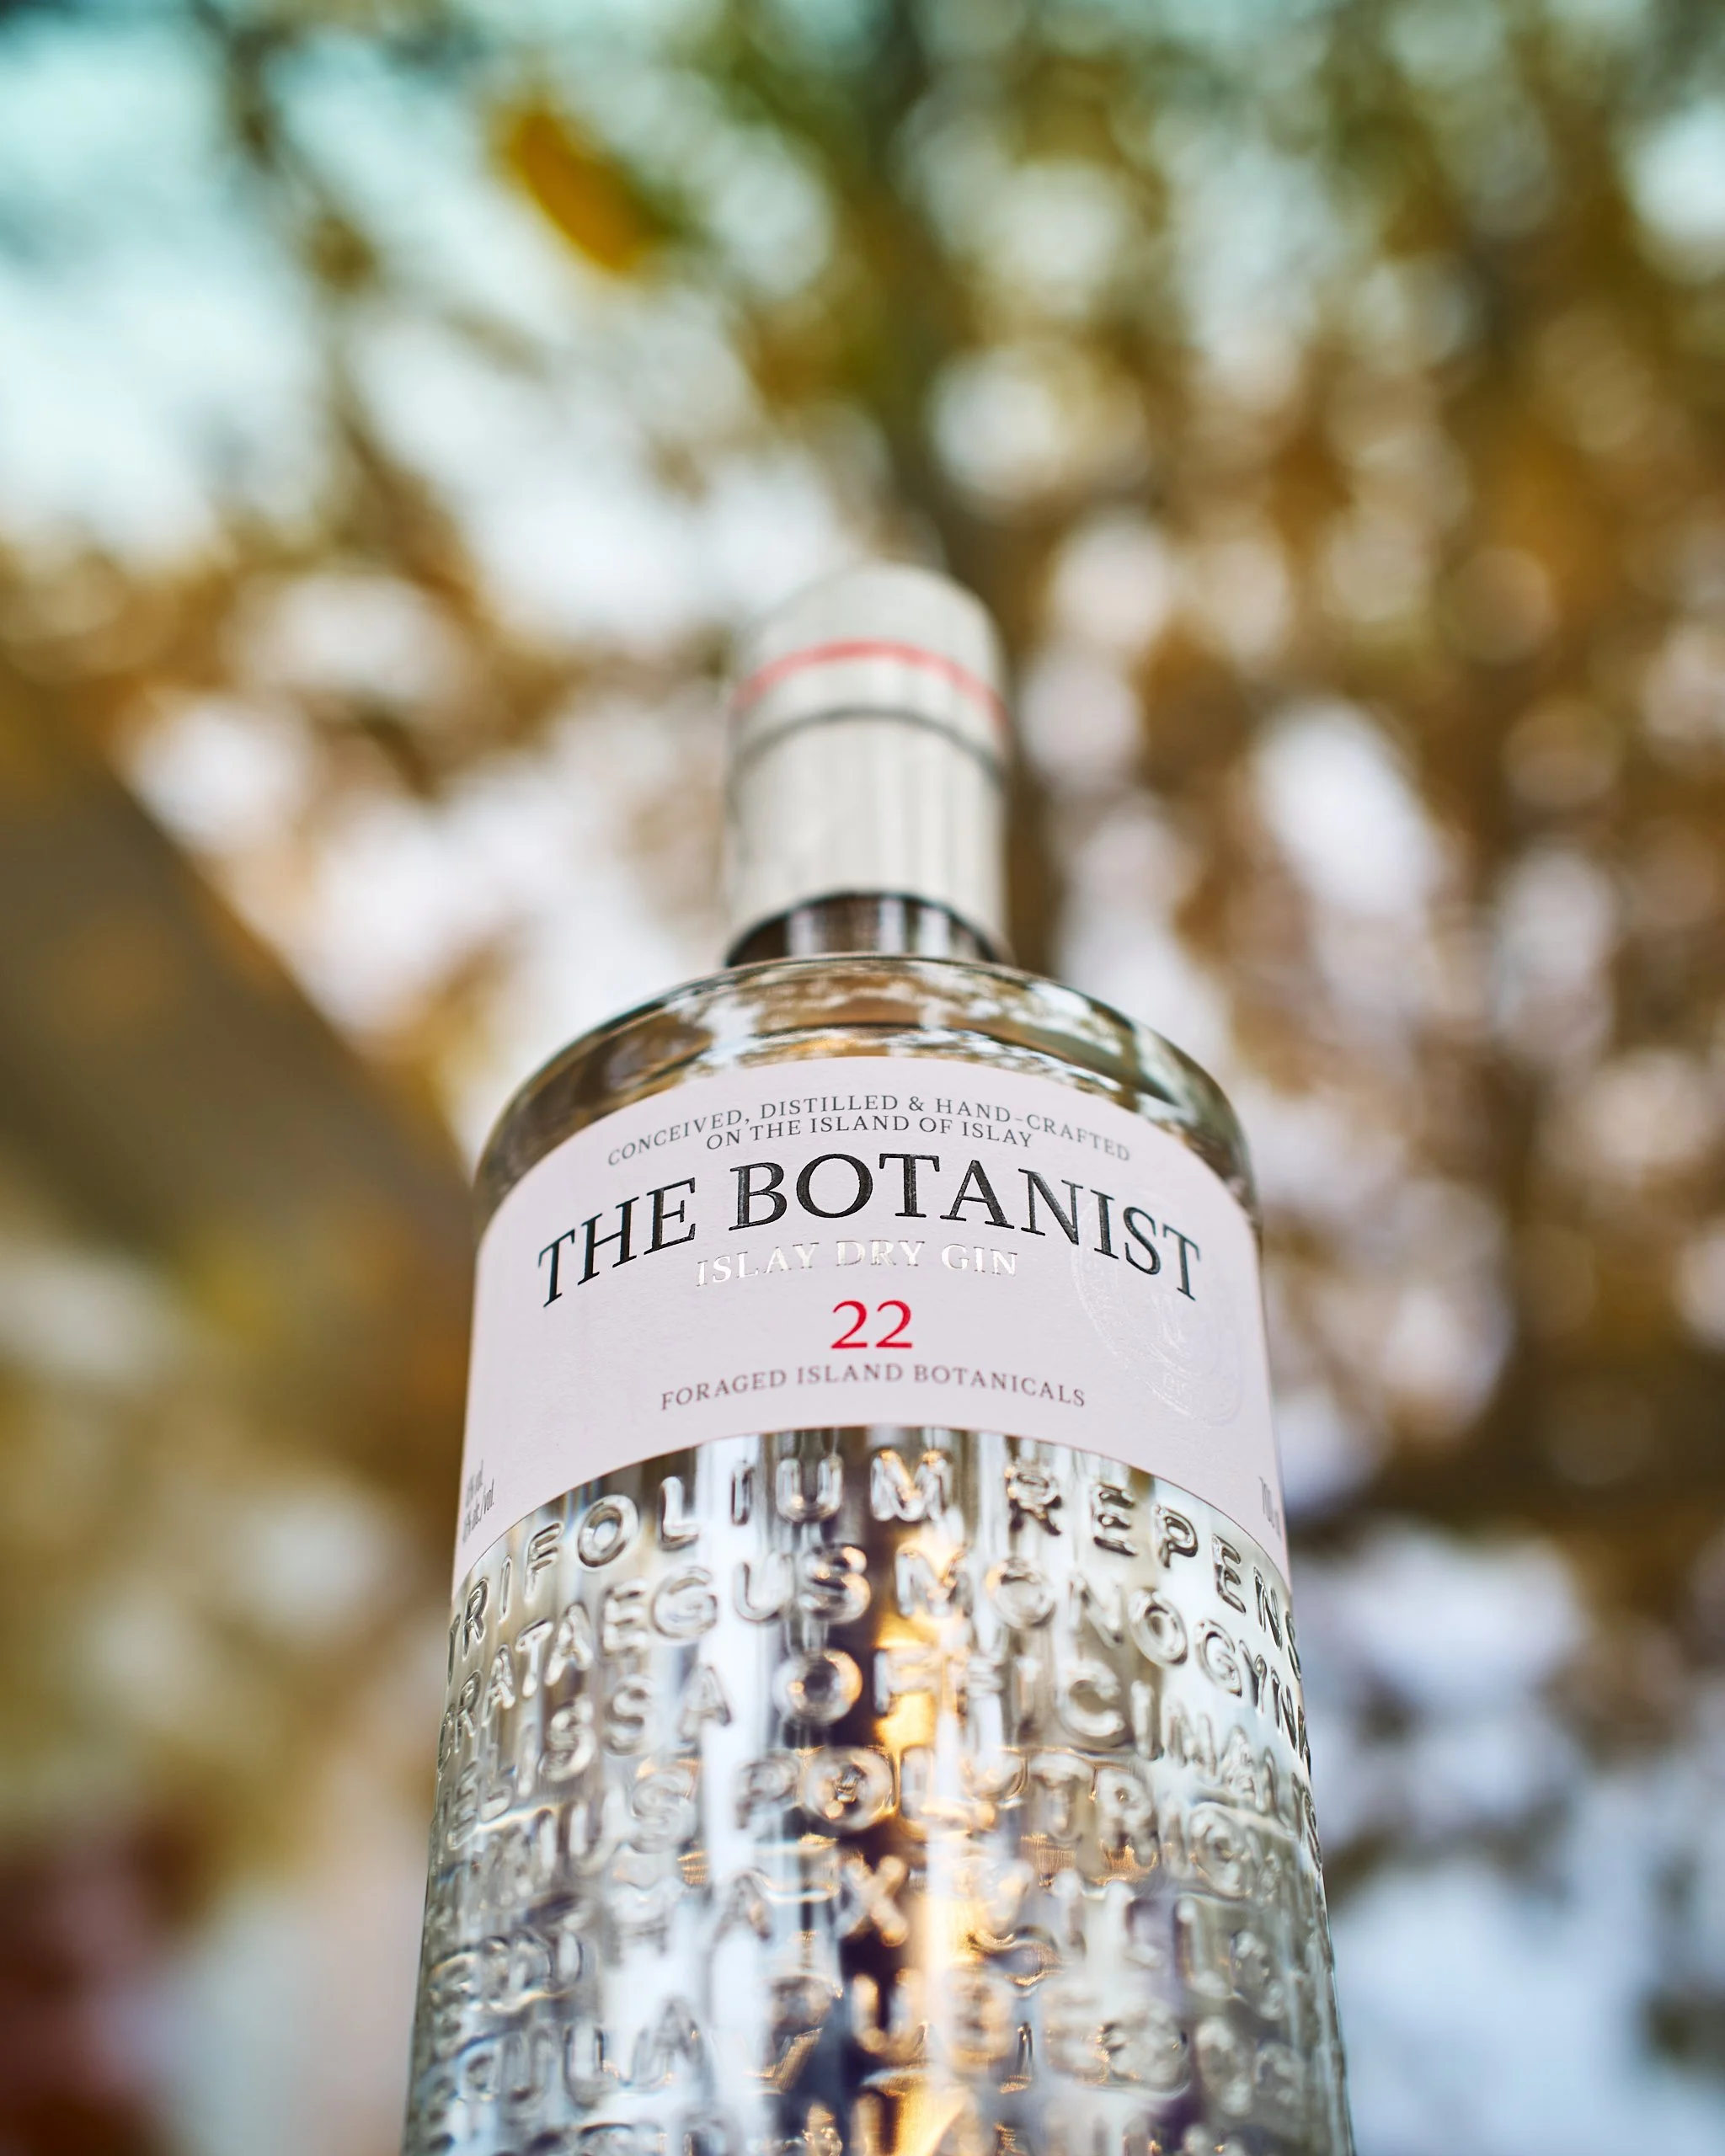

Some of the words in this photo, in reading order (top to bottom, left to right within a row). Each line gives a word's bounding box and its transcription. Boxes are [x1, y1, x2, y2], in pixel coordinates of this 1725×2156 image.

[607, 1108, 750, 1166] CONCEIVED,
[761, 1095, 899, 1119] DISTILLED
[909, 1096, 925, 1113] &
[936, 1098, 1131, 1161] HAND-CRAFTED
[706, 1129, 740, 1150] ON
[750, 1119, 801, 1140] THE
[809, 1115, 910, 1134] ISLAND
[919, 1117, 953, 1134] OF
[962, 1121, 1032, 1148] ISLAY
[537, 1177, 697, 1309] THE
[728, 1153, 1201, 1302] BOTANIST
[696, 1242, 820, 1288] ISLAY
[836, 1240, 926, 1267] DRY
[941, 1244, 1018, 1278] GIN
[830, 1299, 914, 1349] 22
[660, 1369, 788, 1412] FORAGED
[798, 1363, 904, 1385] ISLAND
[914, 1364, 1087, 1408] BOTANICALS
[1007, 1454, 1302, 1681] REPENS
